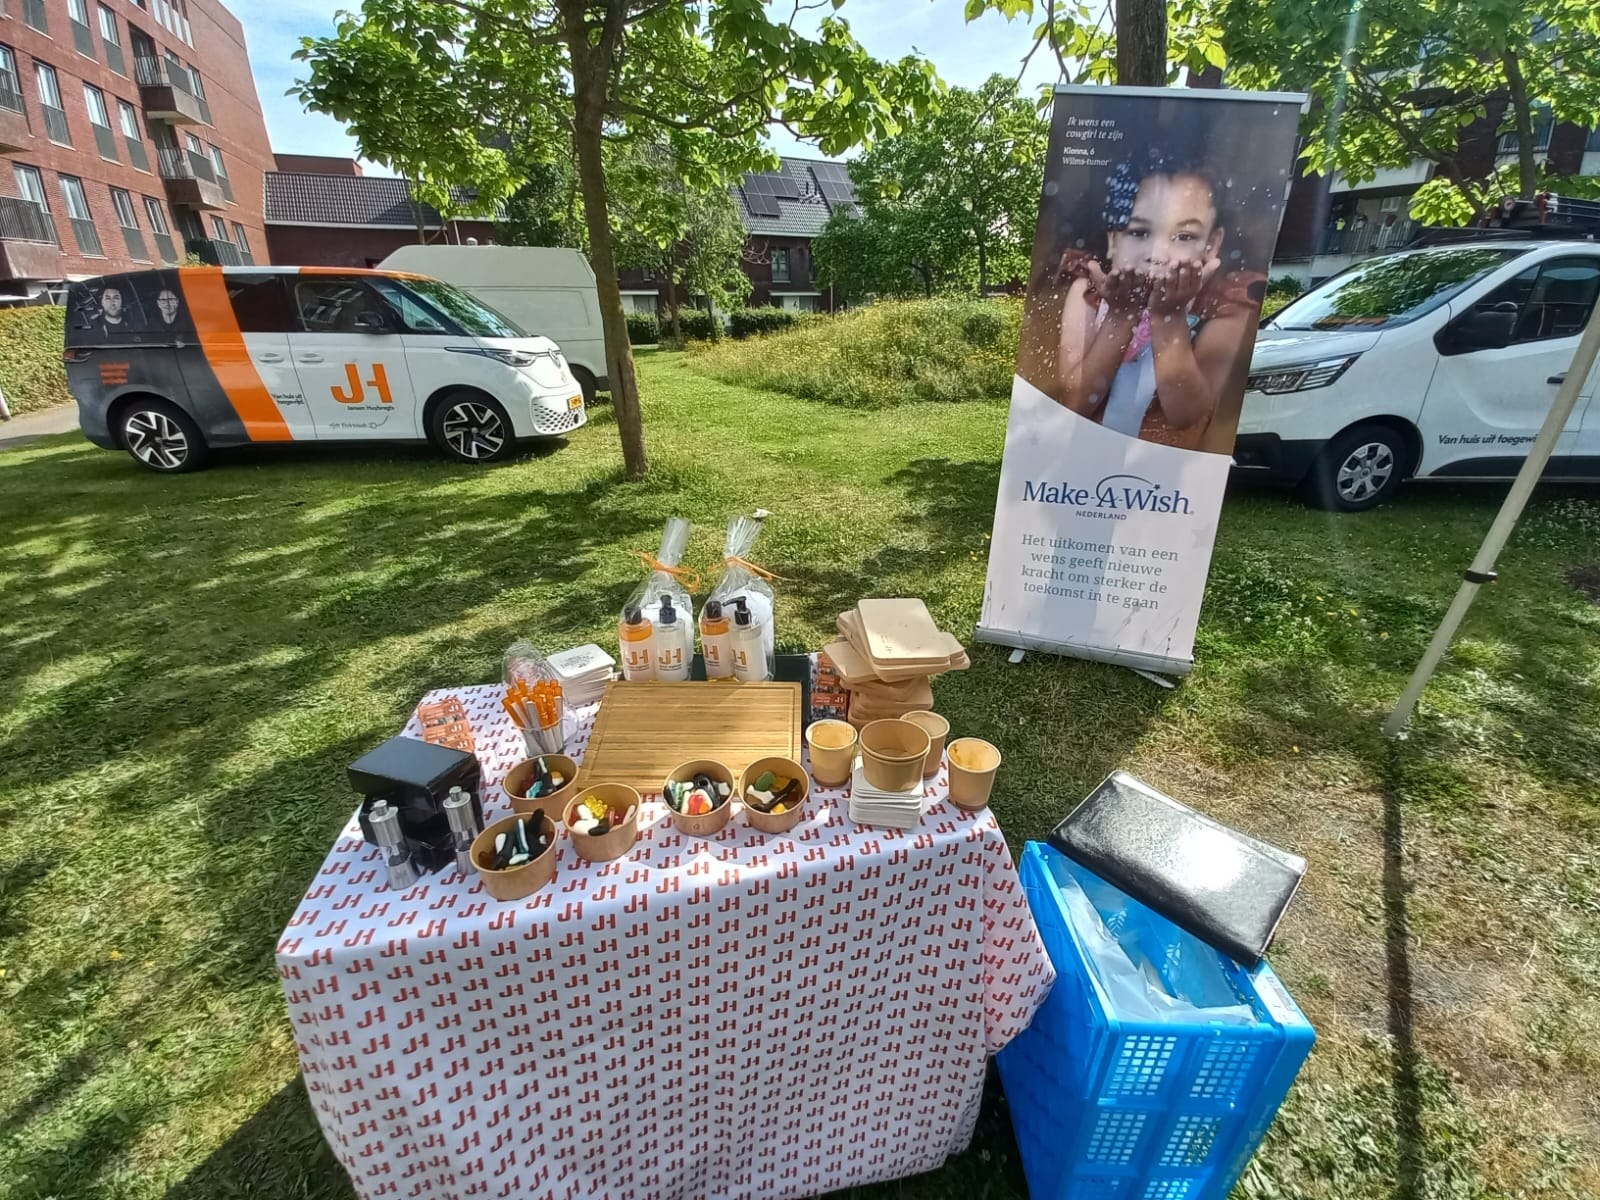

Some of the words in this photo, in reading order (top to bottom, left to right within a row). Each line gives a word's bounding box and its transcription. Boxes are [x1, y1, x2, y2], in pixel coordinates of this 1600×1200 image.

[1068, 116, 1077, 126] Ik
[1100, 120, 1116, 128] een
[1066, 129, 1098, 140] cowgirl
[1098, 130, 1107, 139] te
[1108, 130, 1124, 142] zijn
[330, 363, 393, 403] JH
[1439, 434, 1456, 444] Van
[1458, 434, 1480, 444] huis
[1482, 434, 1496, 444] uit
[1075, 510, 1128, 521] NEDERLAND
[1021, 534, 1045, 547] Het
[1049, 537, 1115, 554] uitkomen
[1120, 546, 1146, 558] van
[1151, 549, 1178, 561] een
[1031, 551, 1066, 565] wens
[1069, 554, 1103, 570] geeft
[1108, 560, 1162, 576] nieuwe
[1020, 565, 1064, 580] kracht
[1068, 571, 1089, 584] om
[1094, 574, 1146, 592] sterker
[1149, 580, 1167, 594] de
[1024, 582, 1084, 599] toekomst
[1088, 590, 1102, 601] in
[1106, 592, 1119, 603] te
[1123, 595, 1159, 610] gaan
[658, 648, 681, 664] JH
